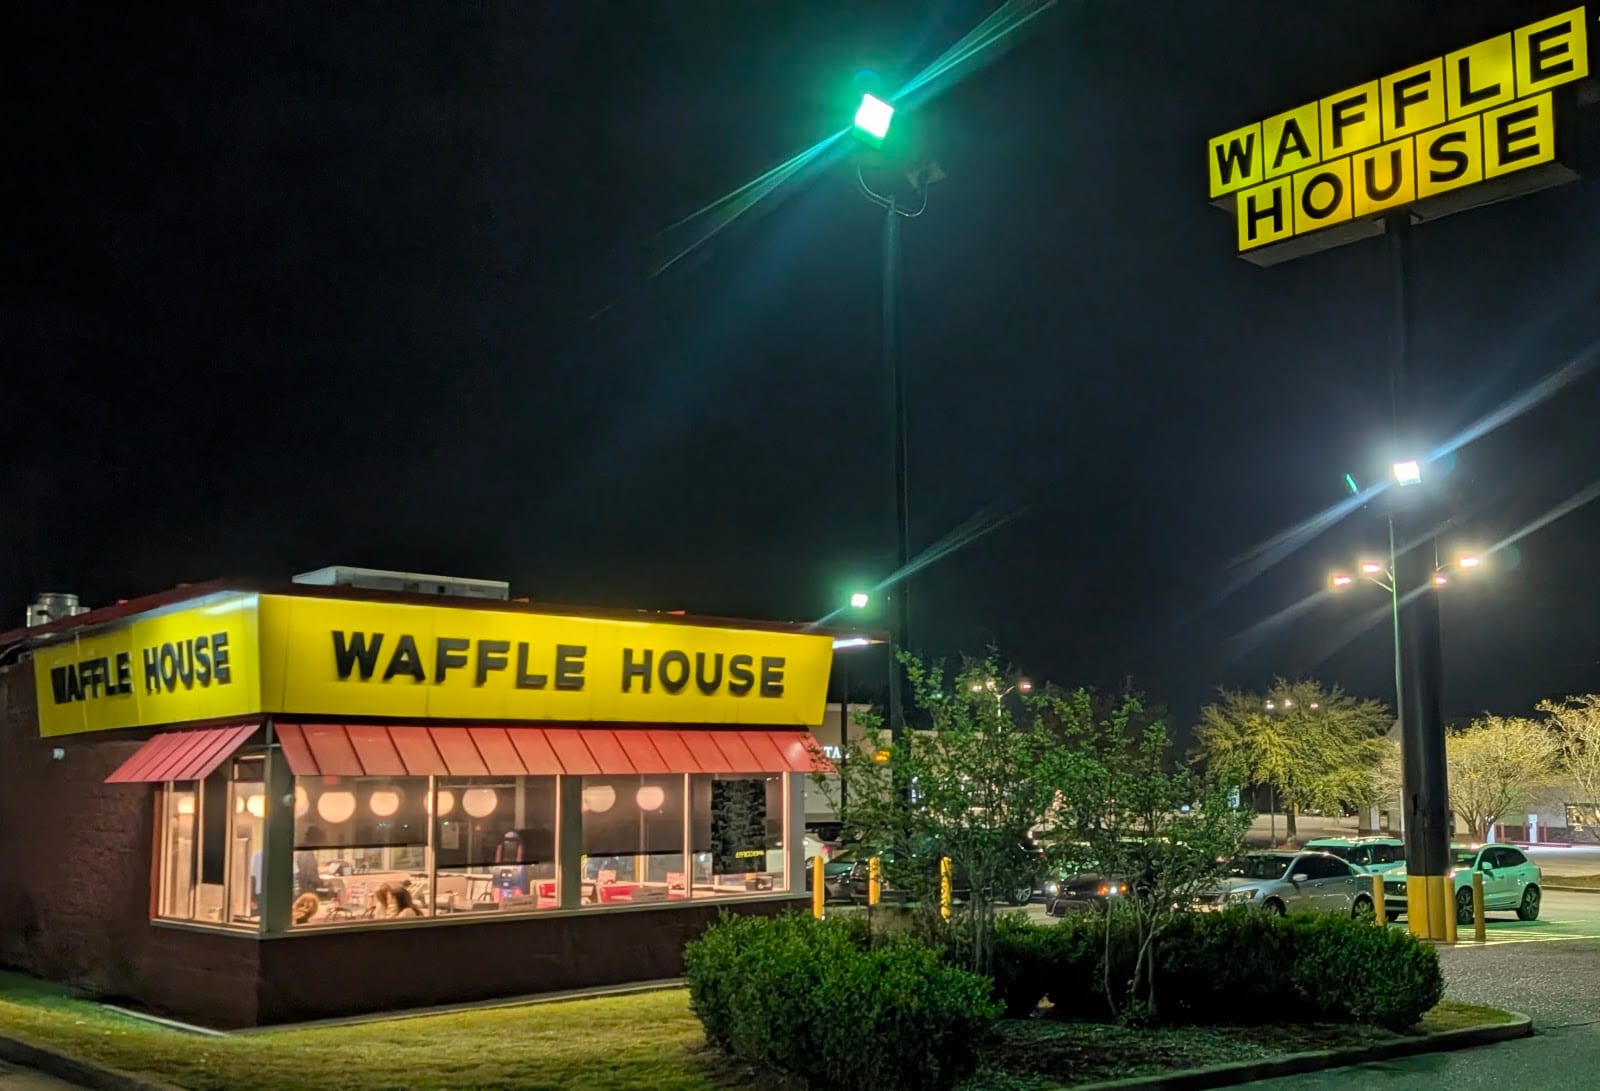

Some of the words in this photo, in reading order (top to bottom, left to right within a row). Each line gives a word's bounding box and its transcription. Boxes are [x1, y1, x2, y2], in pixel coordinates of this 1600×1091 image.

[1216, 20, 1574, 186] WAFFLE
[1246, 104, 1541, 240] HOUSE
[51, 652, 132, 704] WAFFLE
[143, 632, 231, 695] HOUSE
[332, 630, 587, 690] WAFFLE
[622, 648, 786, 697] HOUSE
